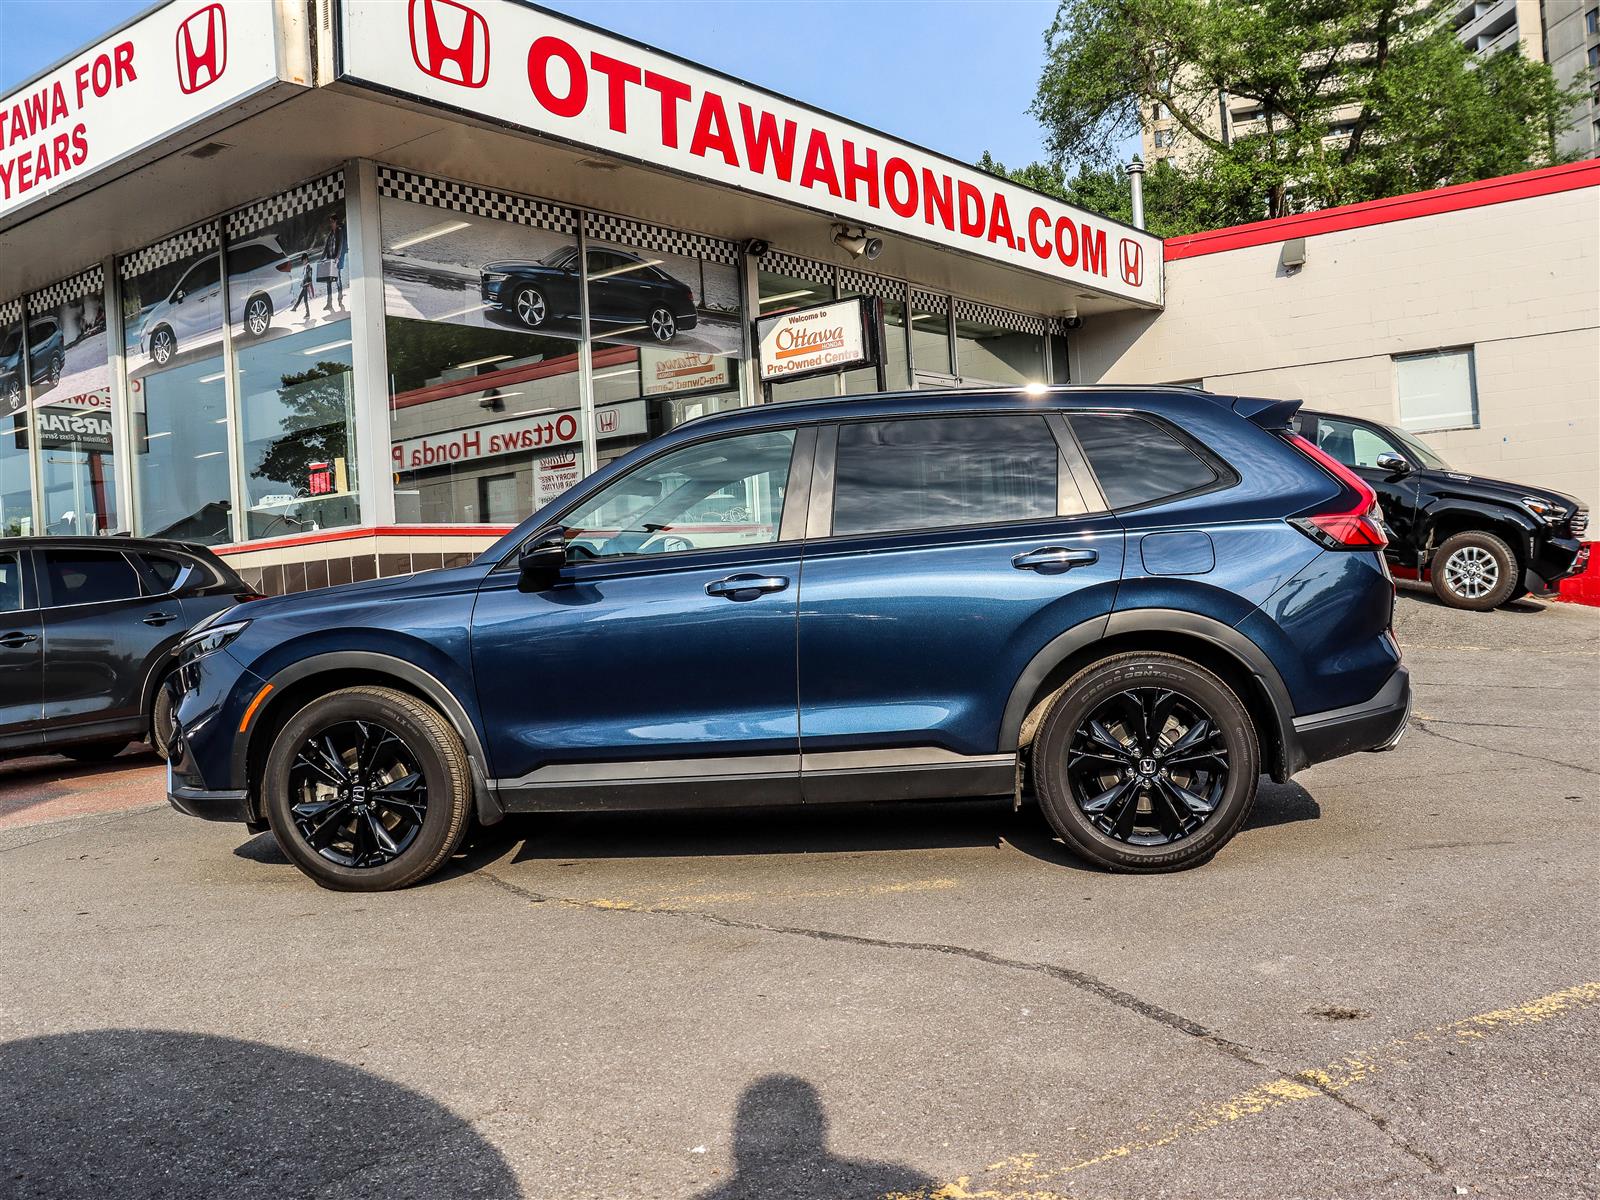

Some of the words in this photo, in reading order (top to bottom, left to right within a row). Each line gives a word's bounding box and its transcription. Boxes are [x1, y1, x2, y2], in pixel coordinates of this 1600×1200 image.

[0, 80, 69, 150] TAWA
[75, 41, 137, 110] FOR
[0, 123, 88, 200] YEARS
[527, 36, 1108, 278] OTTAWAHONDA.COM
[775, 326, 844, 350] Ottawa
[788, 312, 819, 325] Welcome
[820, 310, 827, 318] to
[767, 356, 822, 374] Pre-Owned
[824, 349, 859, 363] Centre
